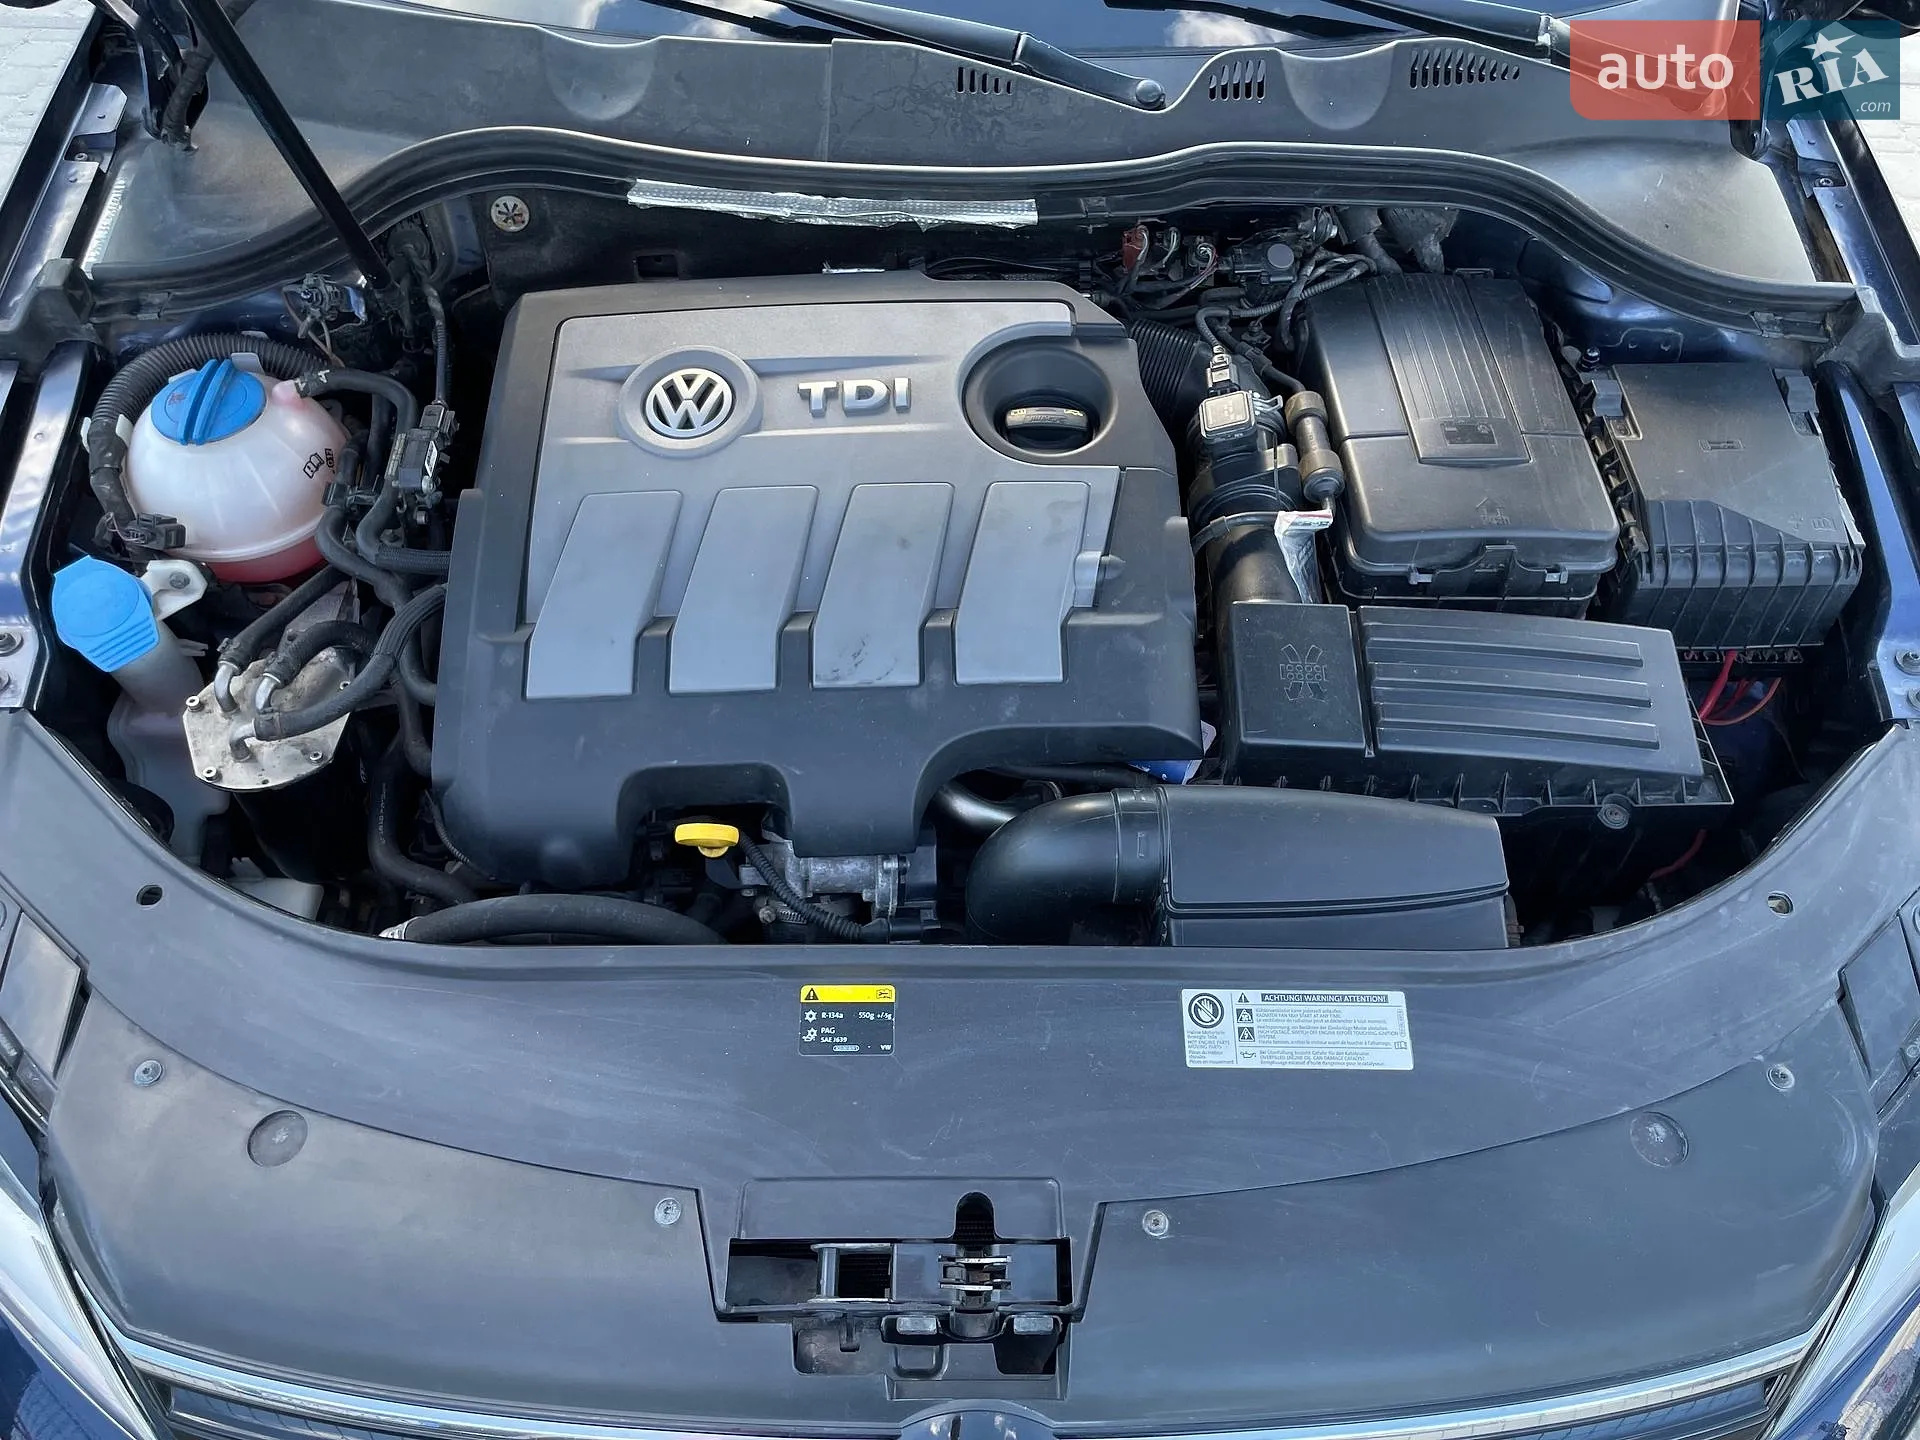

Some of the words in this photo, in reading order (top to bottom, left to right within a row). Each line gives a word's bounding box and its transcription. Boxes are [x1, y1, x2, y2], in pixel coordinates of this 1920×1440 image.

[798, 377, 912, 418] TDI
[1264, 993, 1303, 1003] ACHTUNG!
[1304, 993, 1343, 1003] WARNING!
[1343, 994, 1387, 1004] ATTENTION!
[858, 1012, 875, 1021] 550g
